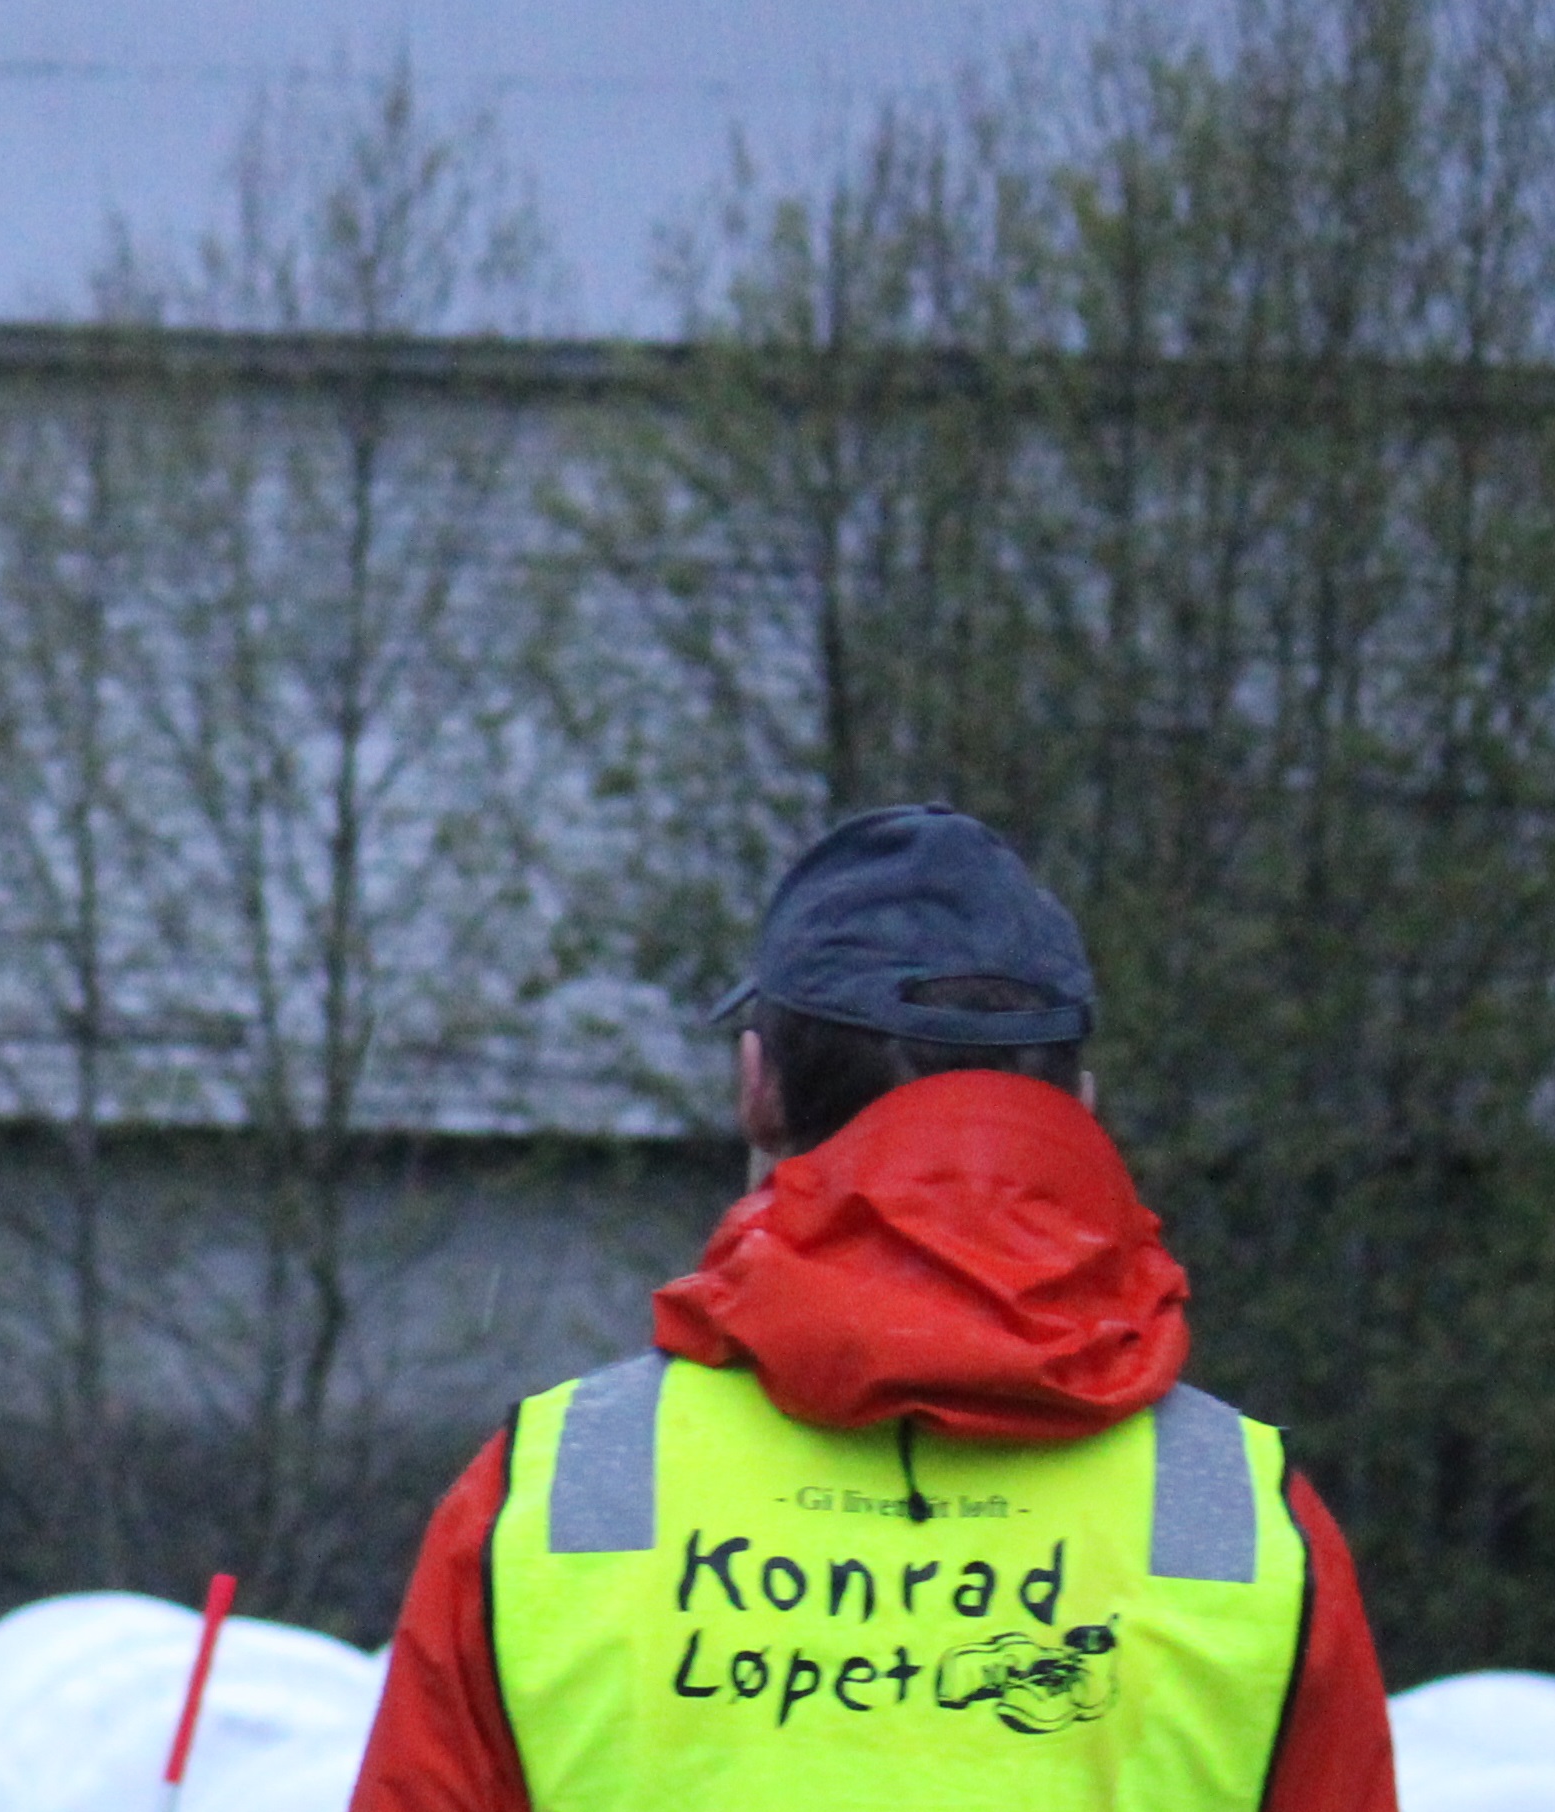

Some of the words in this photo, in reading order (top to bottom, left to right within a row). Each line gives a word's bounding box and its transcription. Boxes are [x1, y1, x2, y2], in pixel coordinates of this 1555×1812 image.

[795, 1485, 834, 1511] Gi
[677, 1528, 1067, 1626] Konrad
[674, 1628, 923, 1728] Løpet
